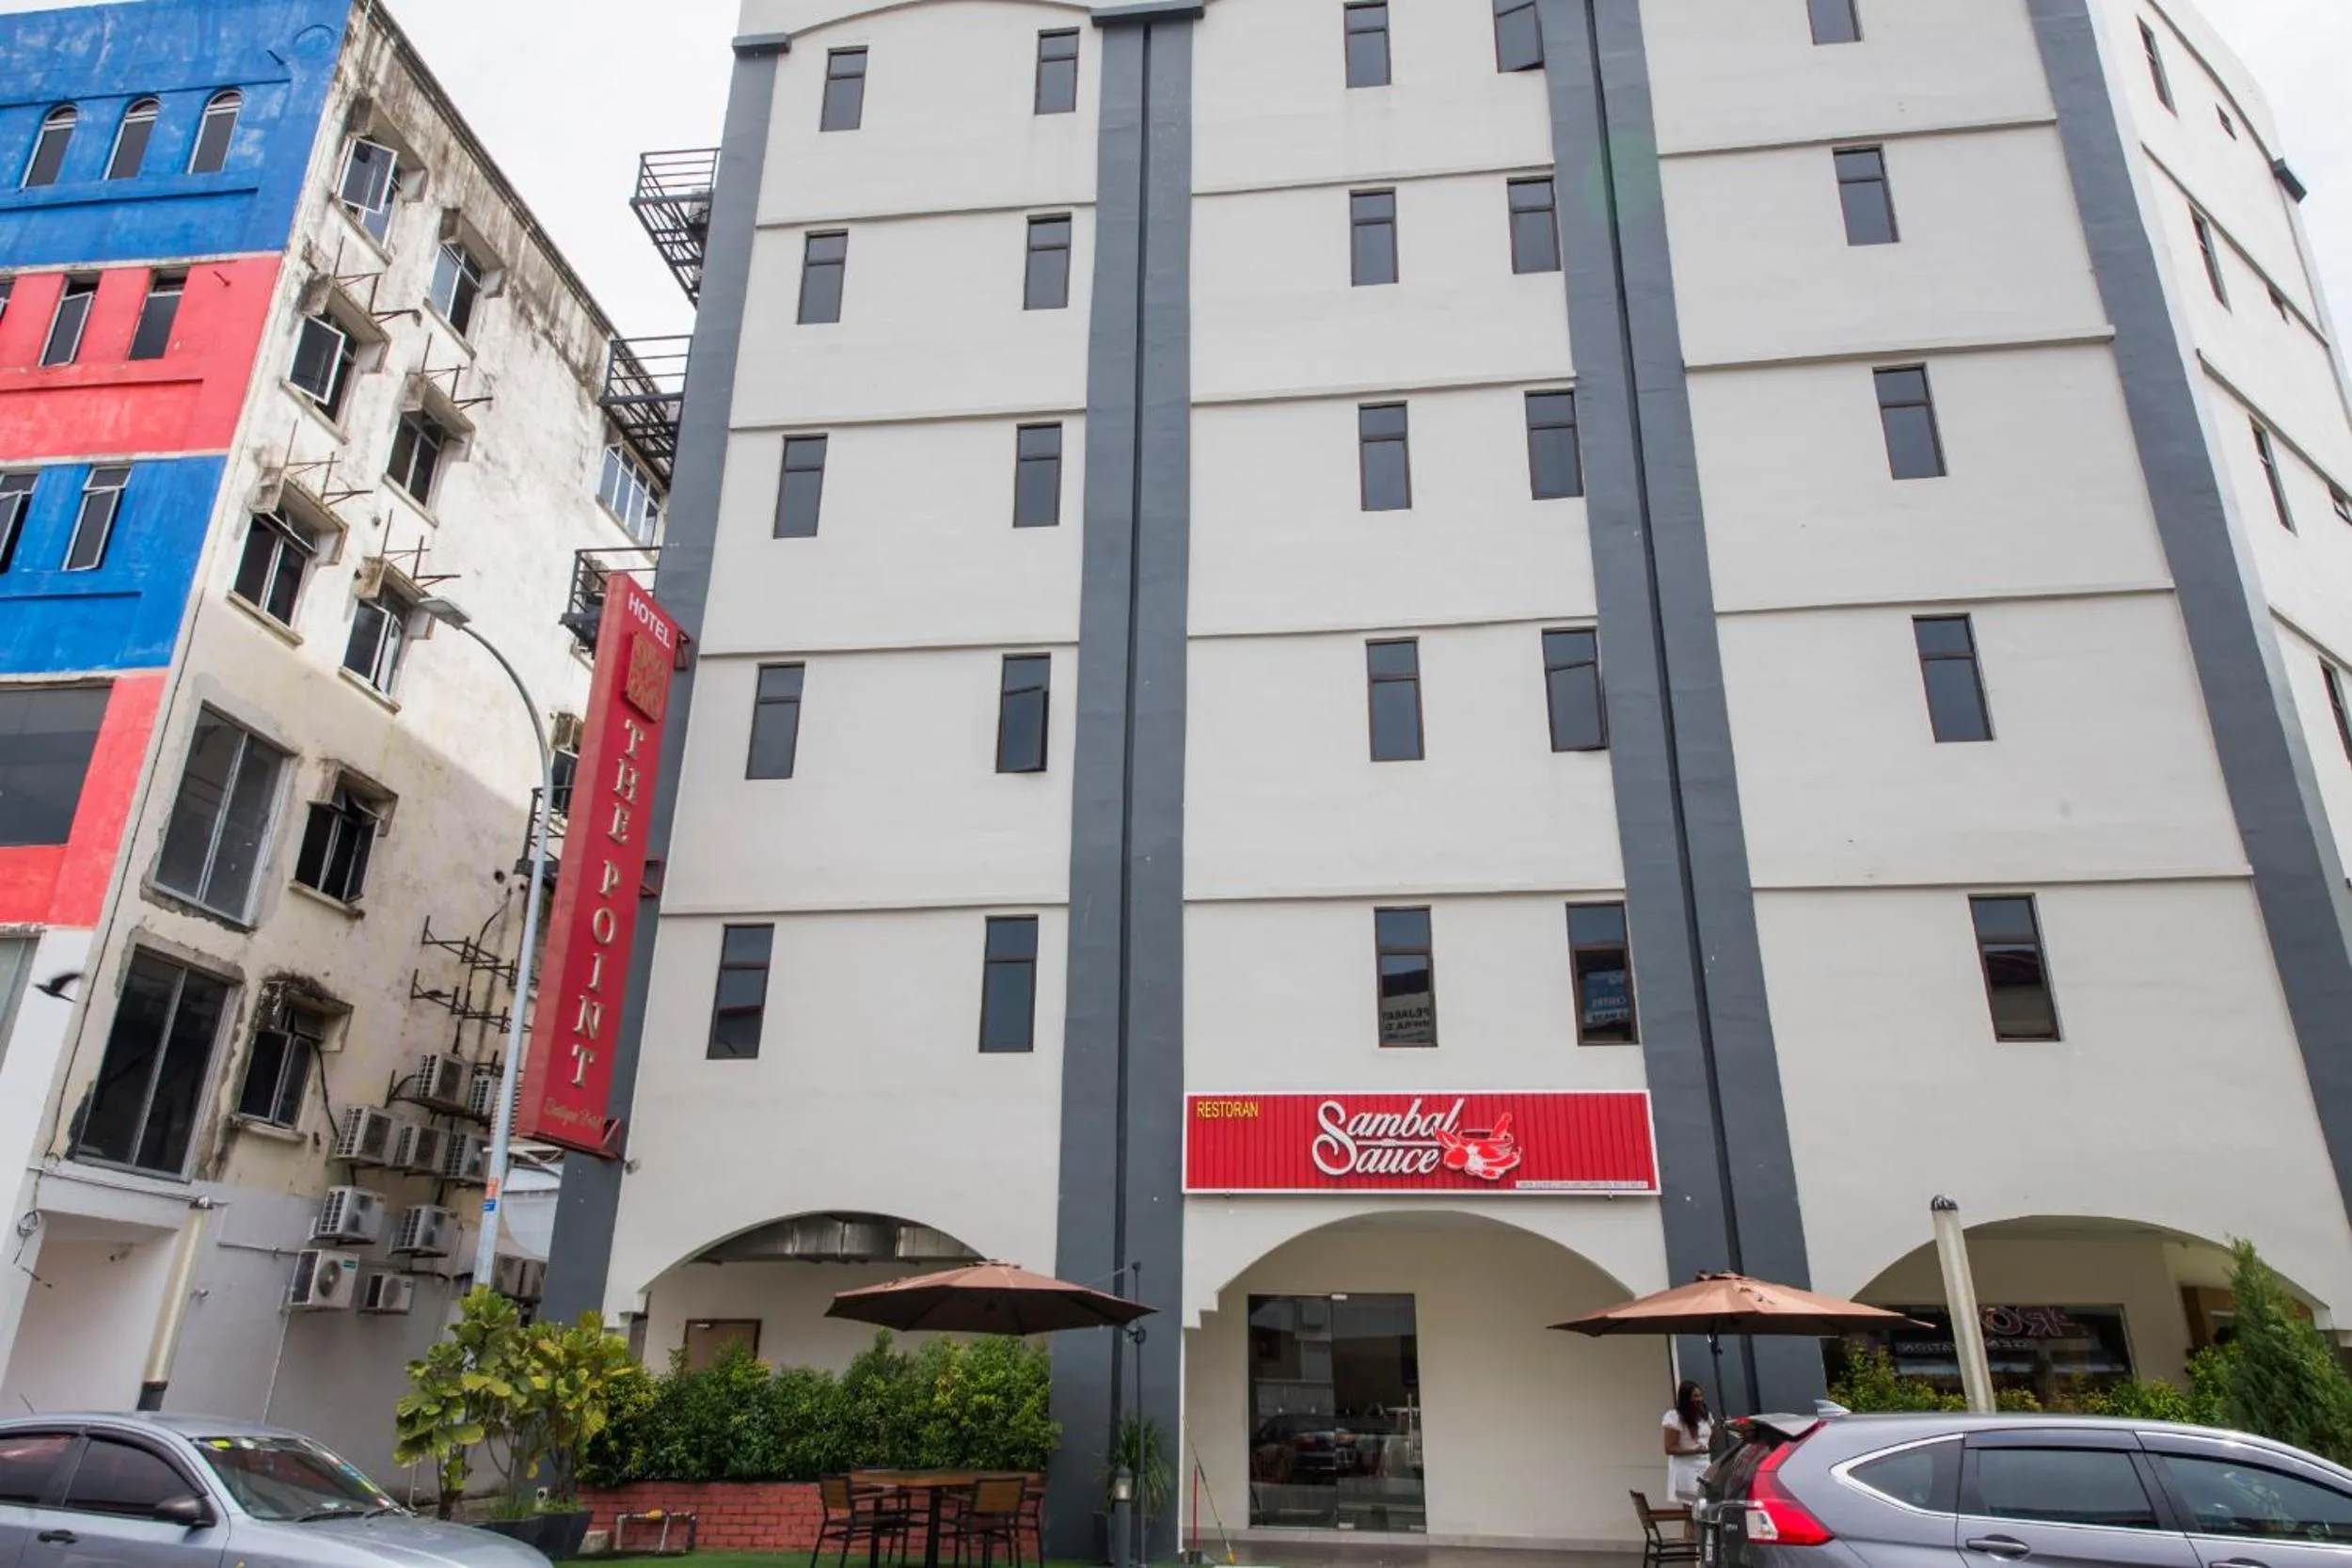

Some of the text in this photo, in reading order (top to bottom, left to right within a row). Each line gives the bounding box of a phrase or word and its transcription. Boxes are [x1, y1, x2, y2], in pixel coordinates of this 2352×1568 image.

[628, 593, 670, 649] HOTEL
[571, 719, 644, 1088] THE POINT
[1197, 1101, 1259, 1117] RESTORAN
